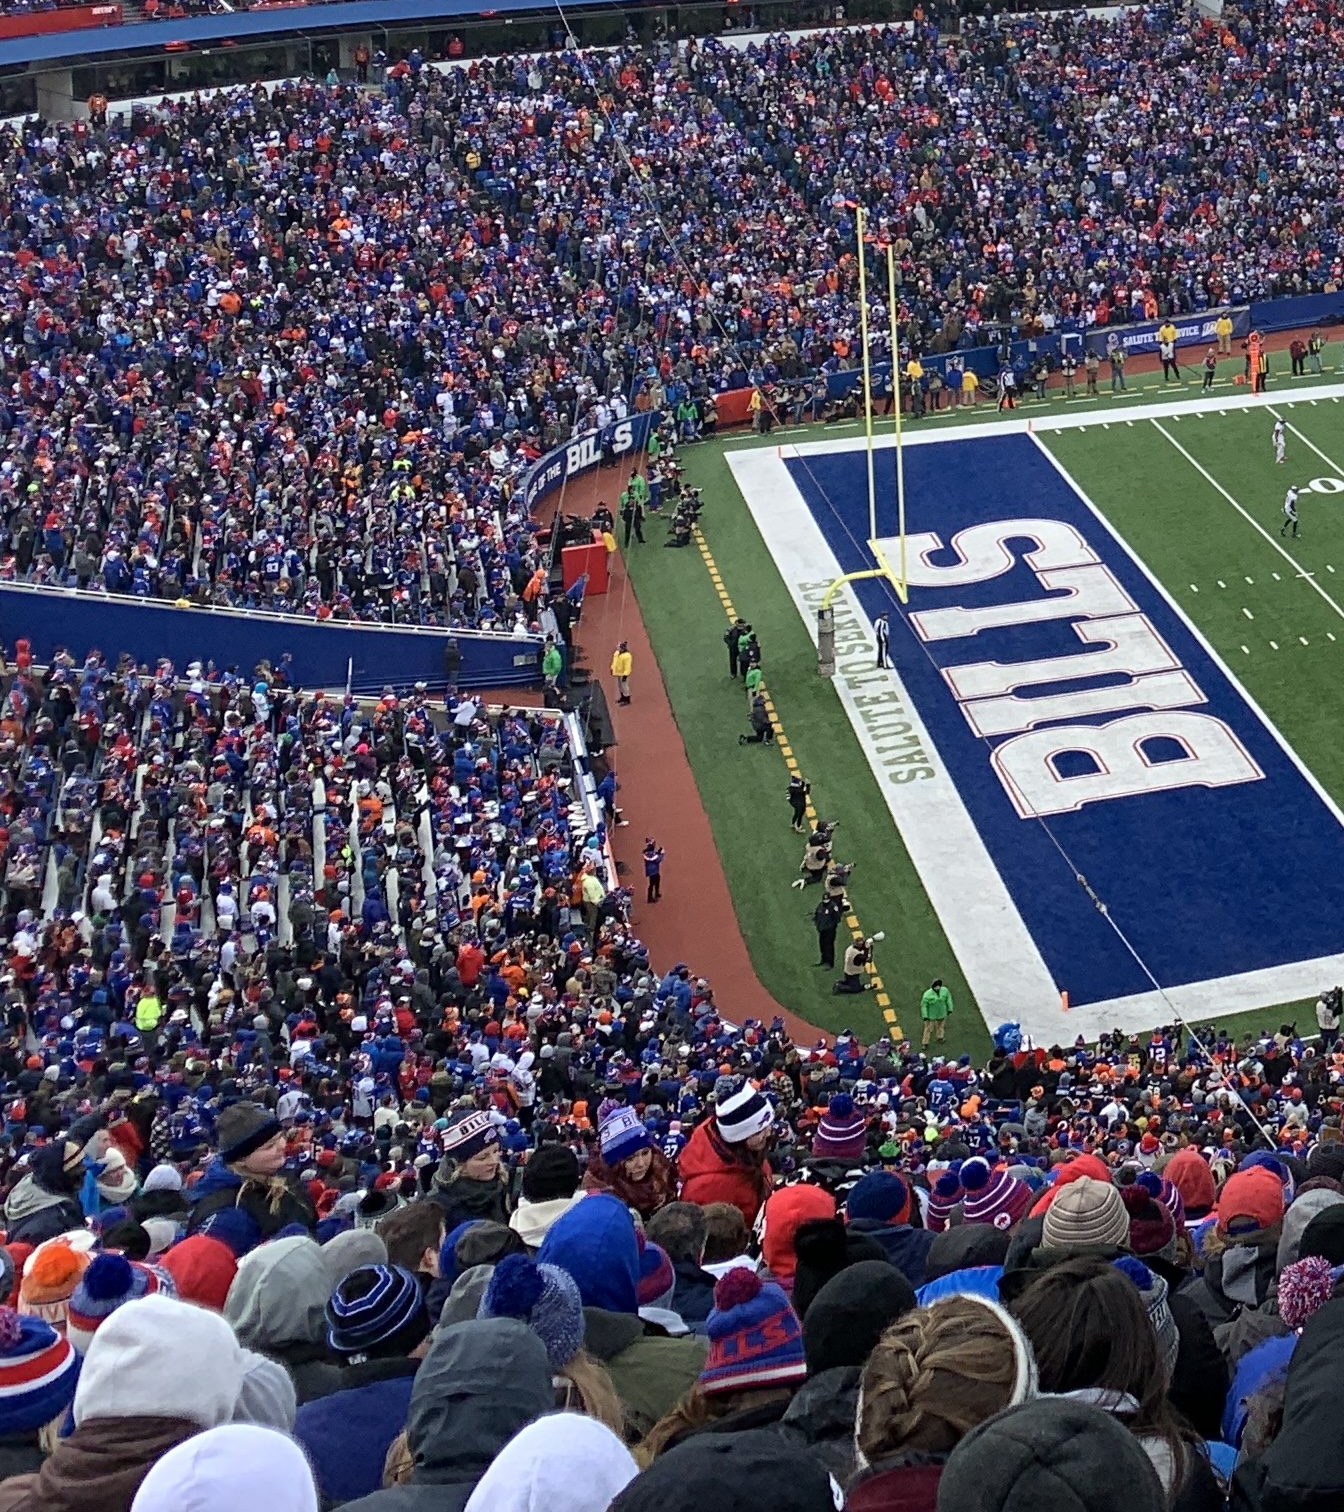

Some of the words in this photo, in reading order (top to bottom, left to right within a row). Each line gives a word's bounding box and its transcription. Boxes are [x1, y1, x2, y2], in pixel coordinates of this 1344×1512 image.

[1123, 334, 1154, 348] SALUTE
[538, 474, 547, 490] OF
[546, 461, 561, 481] THE
[566, 422, 633, 476] BILS
[839, 660, 889, 690] TO
[869, 518, 1266, 819] BILLS
[853, 691, 937, 785] SALUTE
[1150, 1048, 1166, 1063] 12
[931, 1093, 943, 1105] 17
[969, 1135, 981, 1148] 17
[663, 1143, 679, 1158] 27
